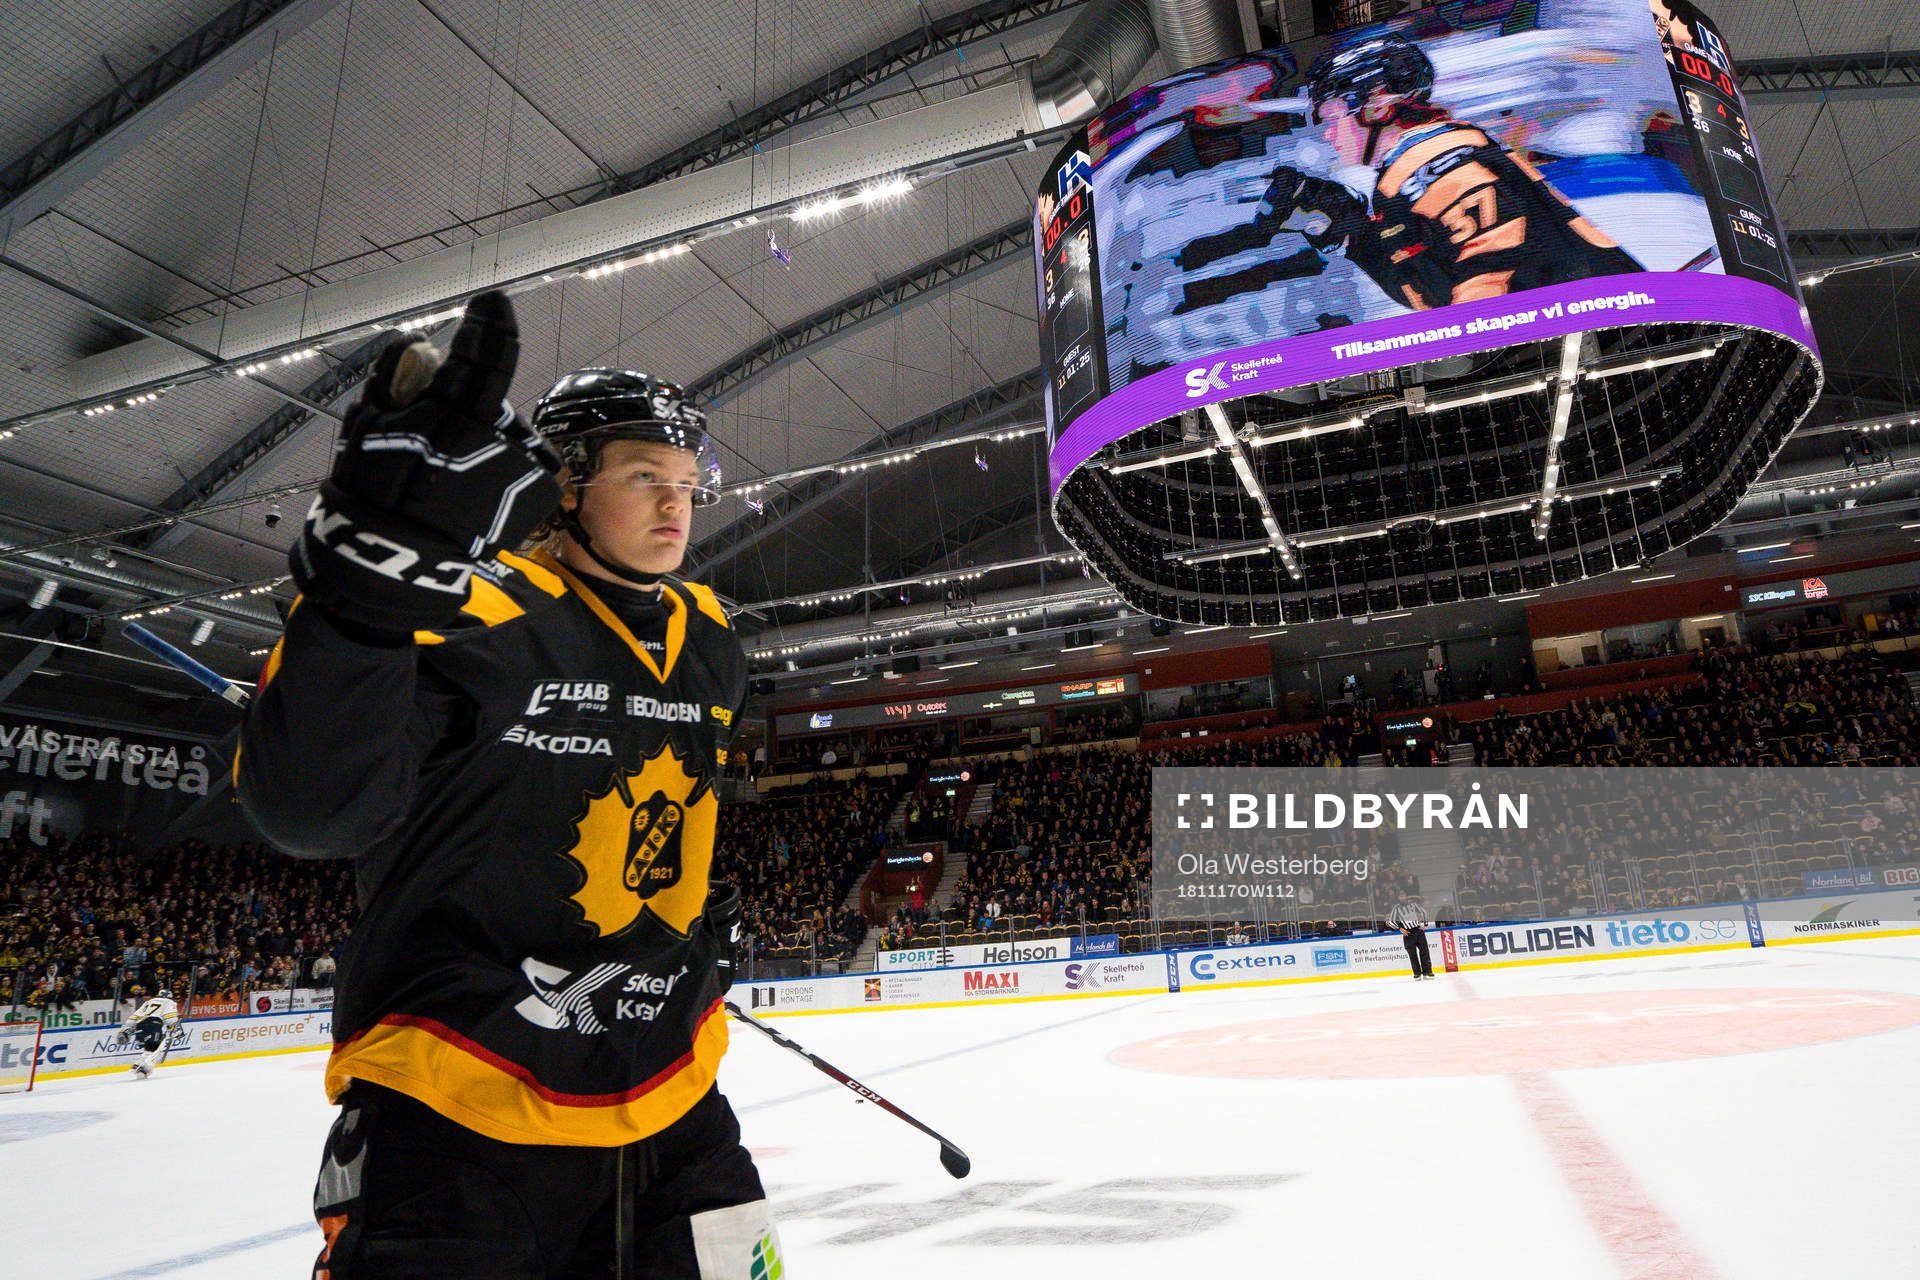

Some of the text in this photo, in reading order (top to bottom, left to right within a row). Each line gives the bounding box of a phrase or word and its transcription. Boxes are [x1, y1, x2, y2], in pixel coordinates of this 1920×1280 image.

[1692, 117, 1710, 133] 36
[1722, 146, 1744, 163] HOME
[1732, 220, 1748, 234] 11
[1330, 291, 1656, 360] Tillsammans skapar vi energin.
[1066, 351, 1090, 380] 01:25
[1231, 354, 1283, 372] Skellefteå
[1232, 368, 1259, 382] Kraft
[1802, 577, 1827, 590] ICA
[559, 682, 610, 702] LEAB
[576, 702, 608, 712] group
[501, 724, 613, 756] ŠKODA
[649, 867, 673, 880] 1921
[1812, 872, 1872, 887] Norrlan Bil
[1794, 919, 1880, 933] NORRMASKINER
[1467, 924, 1595, 957] BOLIDEN
[889, 950, 936, 964] SPORT
[983, 945, 1057, 964] Henson
[1216, 954, 1297, 970] extena
[1103, 962, 1145, 974] Skellefteå
[964, 970, 1020, 990] MAXI
[1104, 974, 1125, 983] Kraft
[780, 986, 814, 996] FORDONS
[974, 988, 1020, 997] STORMARKNAD
[780, 995, 814, 1004] MONTAGE
[191, 1003, 242, 1016] BYNS BYG
[202, 1022, 305, 1042] energiservice
[846, 1080, 881, 1102] CCM
